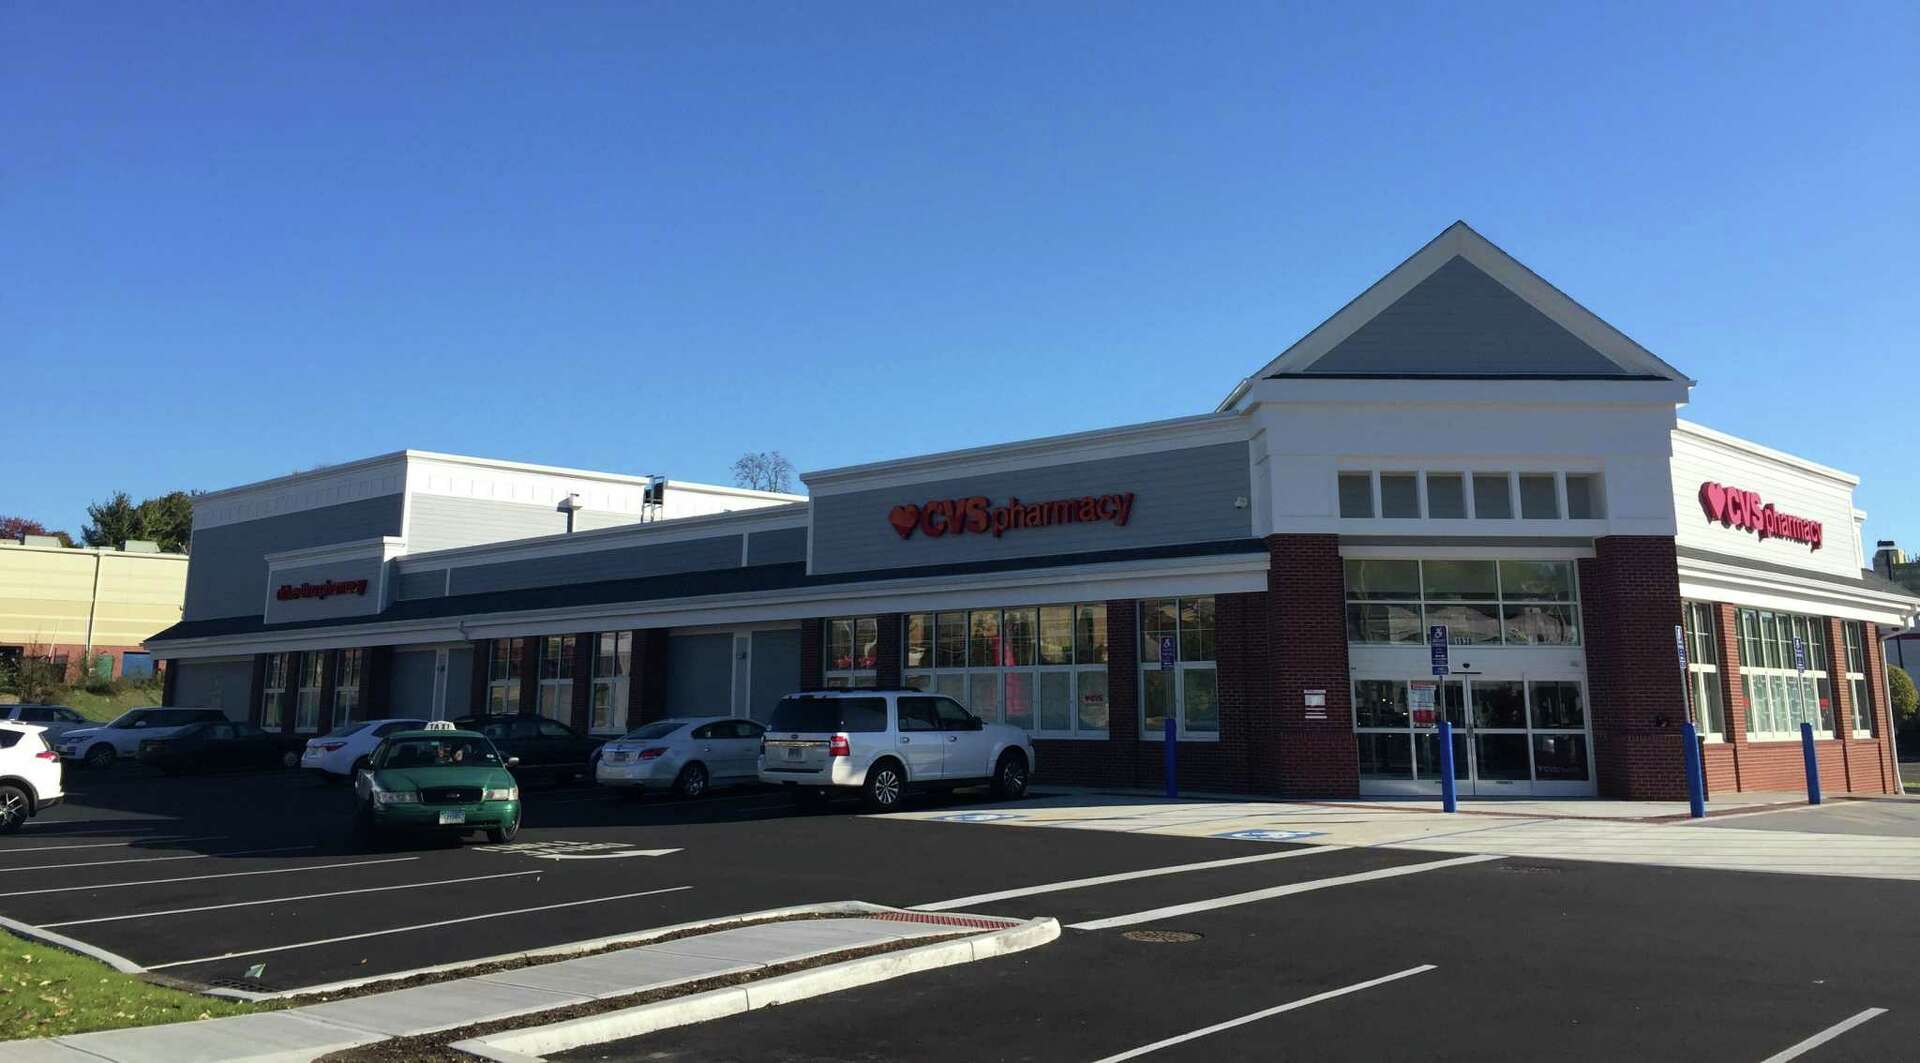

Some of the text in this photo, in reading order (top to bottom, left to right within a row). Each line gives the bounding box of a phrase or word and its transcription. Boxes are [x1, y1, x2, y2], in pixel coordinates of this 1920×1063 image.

[922, 492, 1135, 538] CVS pharmacy
[1723, 486, 1823, 553] CVS pharmacy
